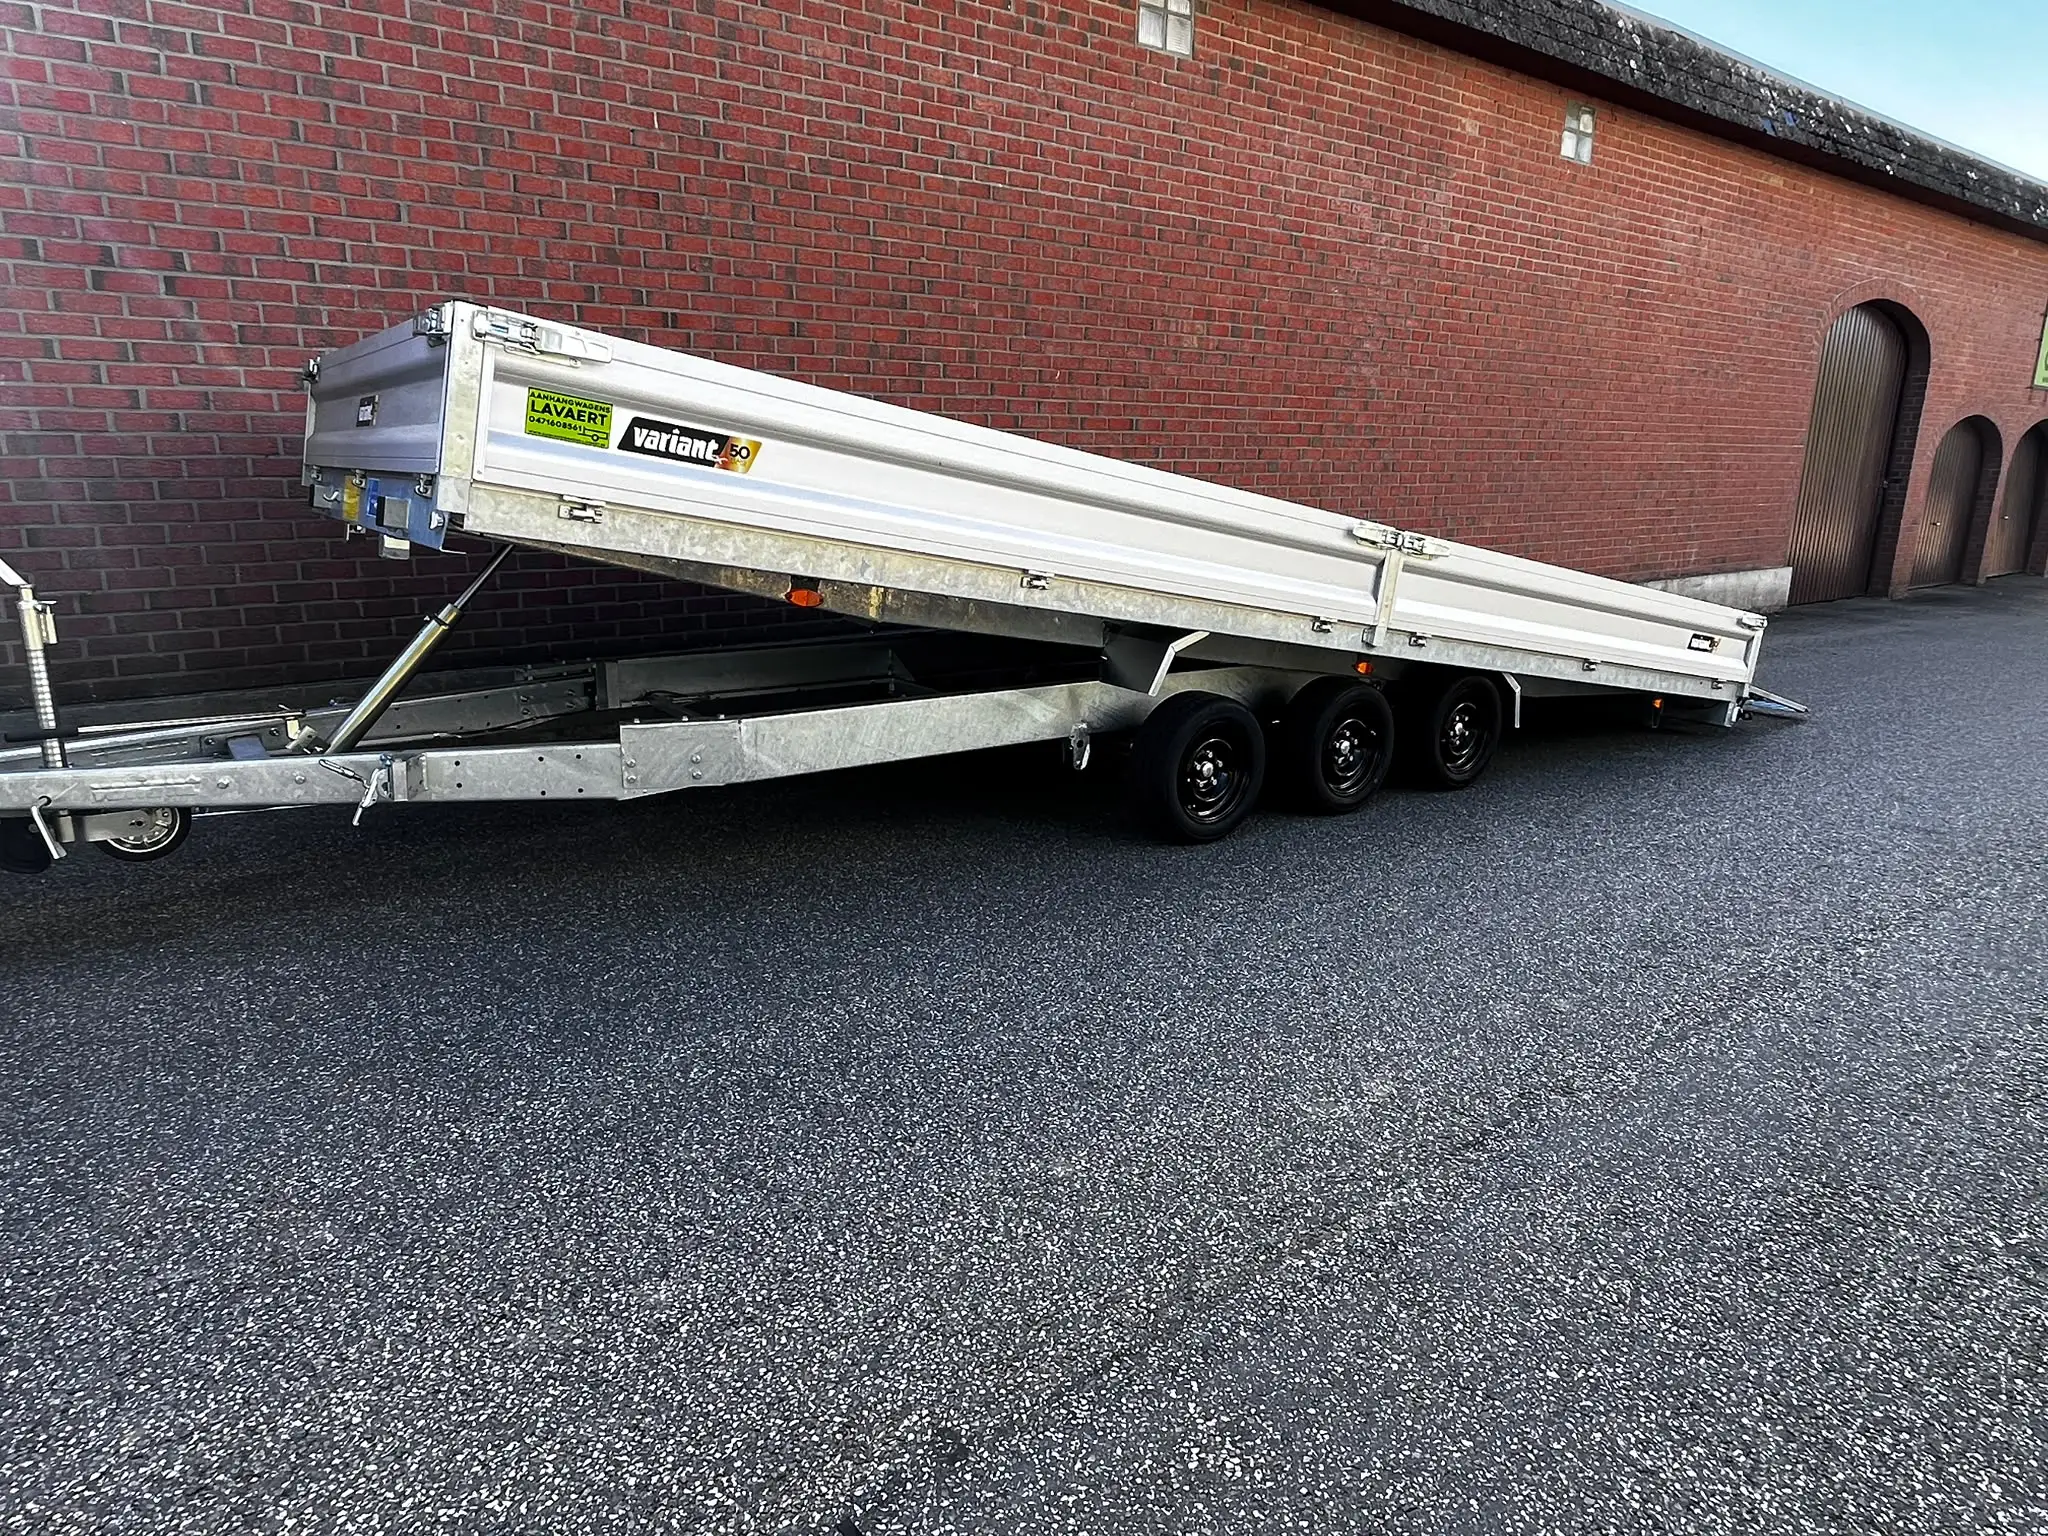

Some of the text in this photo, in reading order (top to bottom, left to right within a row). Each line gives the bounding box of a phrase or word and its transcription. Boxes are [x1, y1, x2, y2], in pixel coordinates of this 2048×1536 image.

[530, 392, 611, 413] AANHANGWAGENS
[531, 400, 608, 426] LAVAERT
[529, 416, 582, 432] 0471608561
[634, 427, 719, 461] variant
[730, 443, 750, 459] 50
